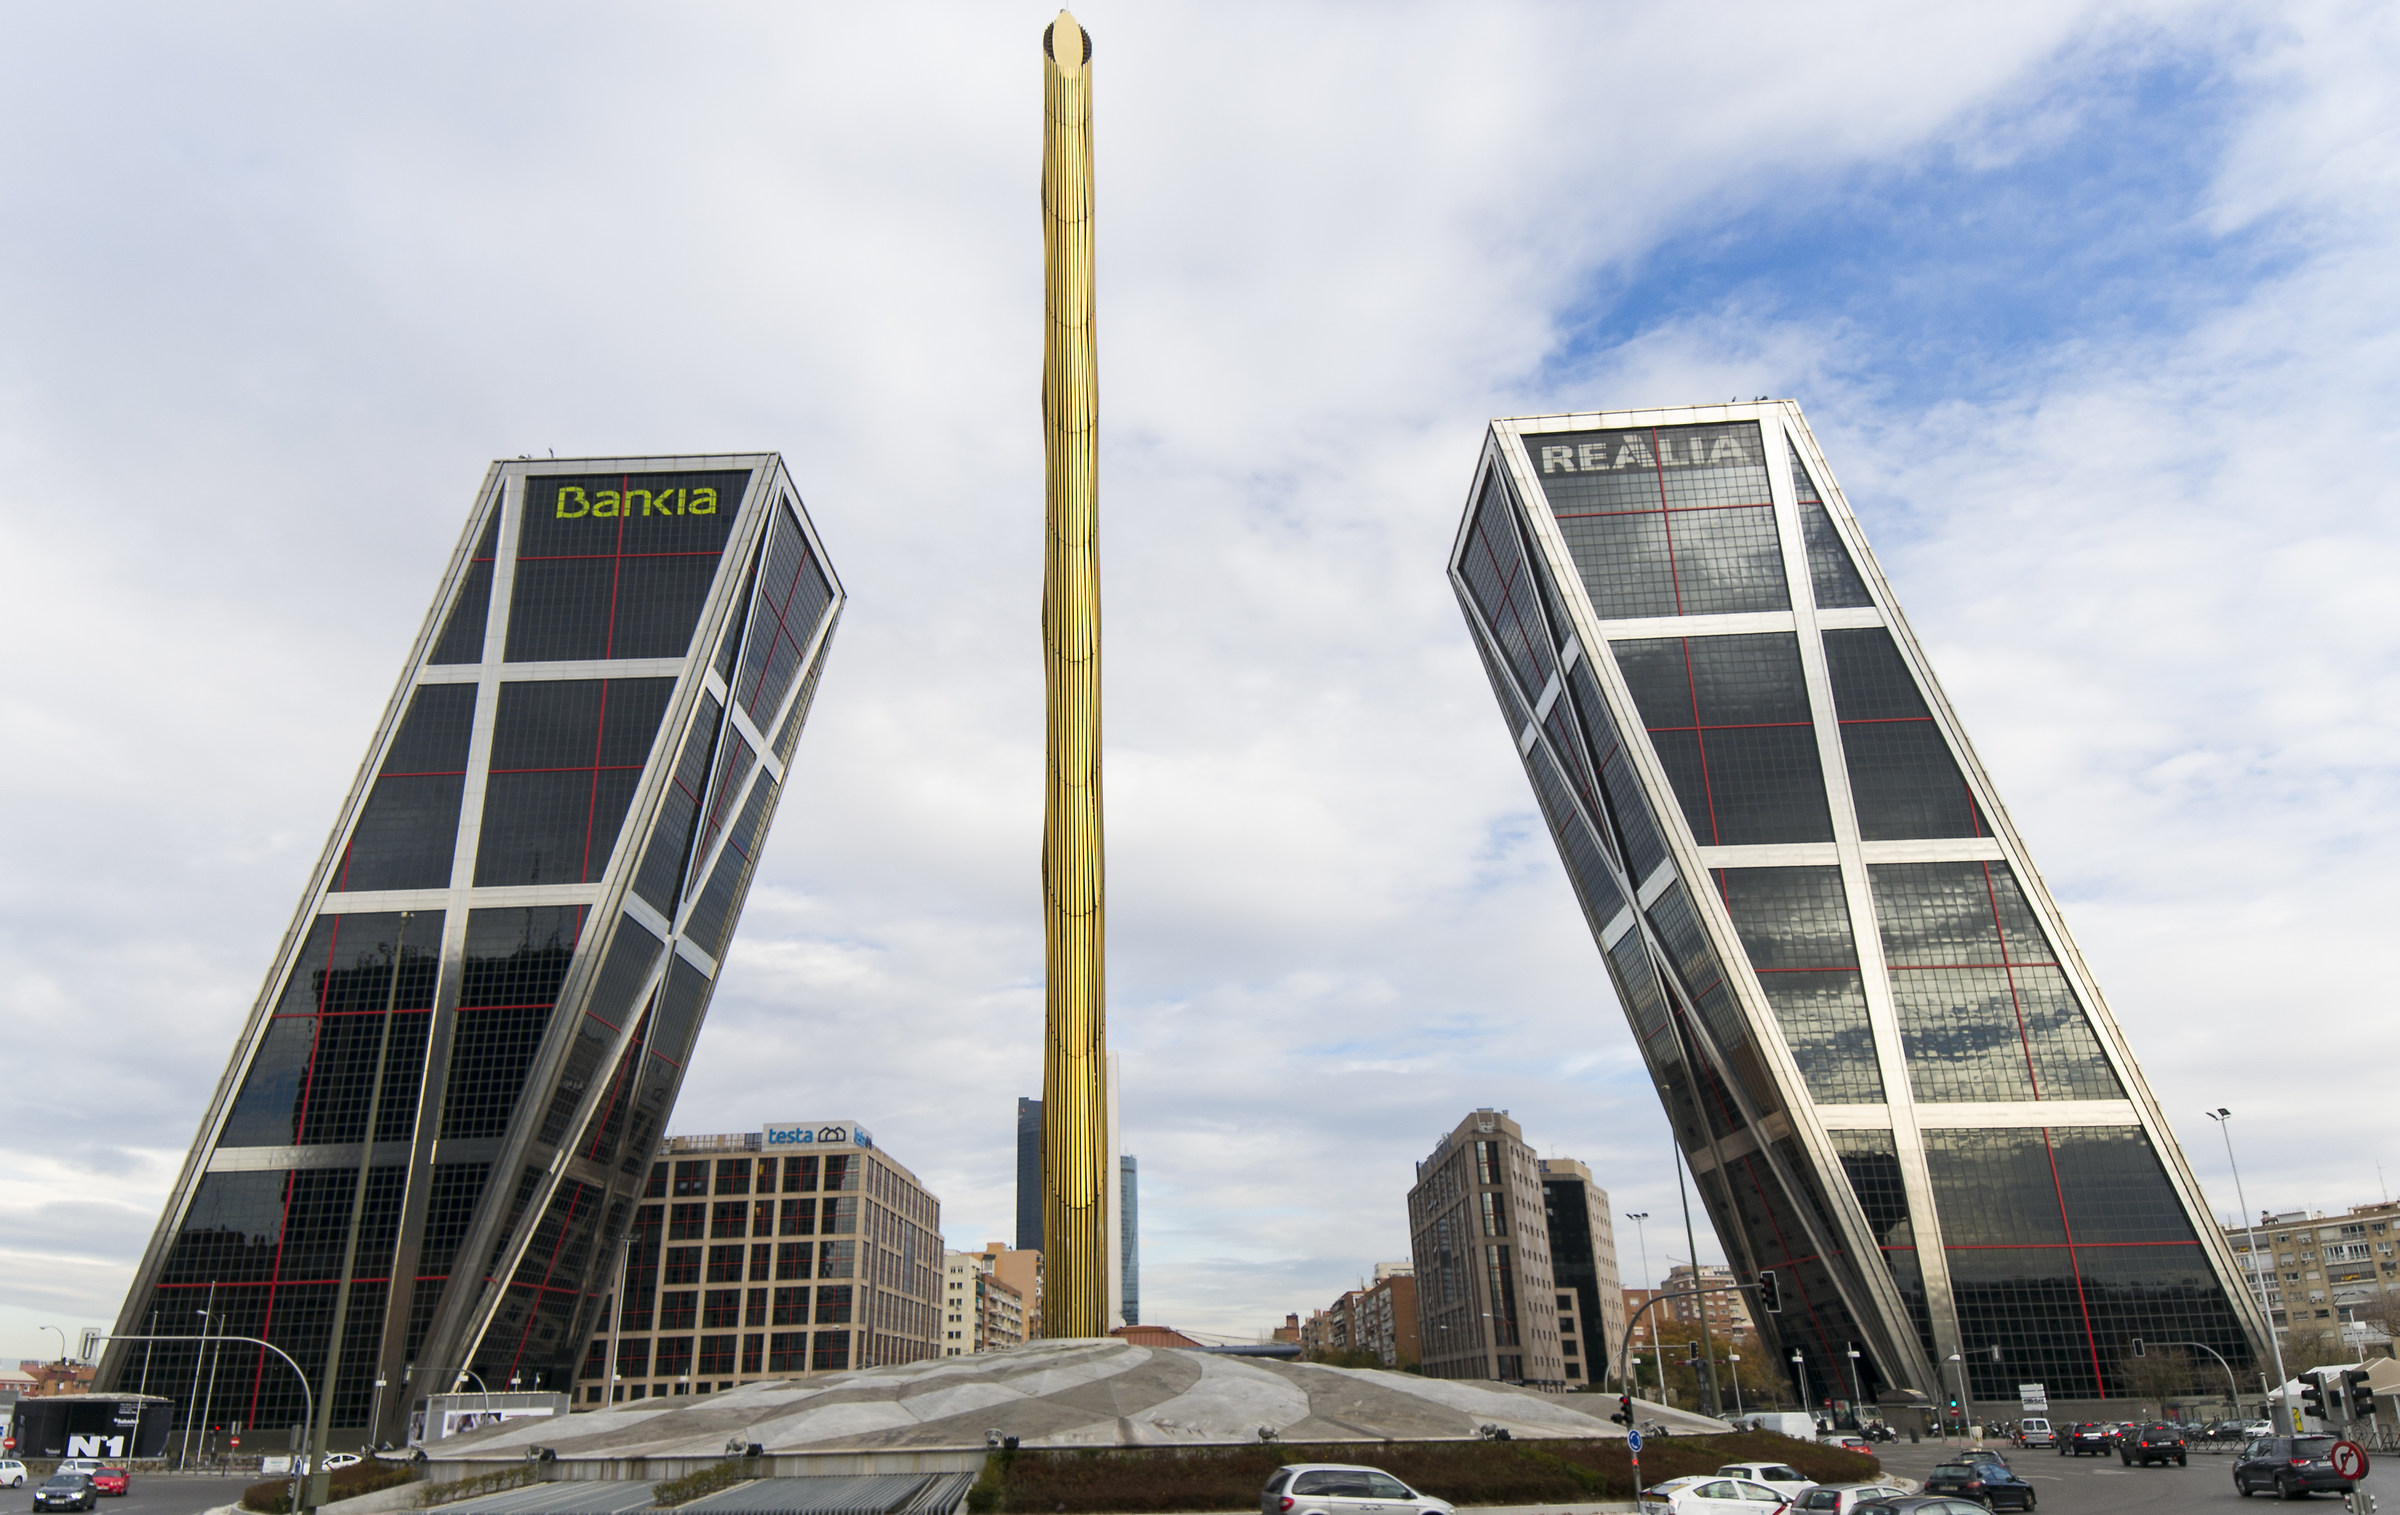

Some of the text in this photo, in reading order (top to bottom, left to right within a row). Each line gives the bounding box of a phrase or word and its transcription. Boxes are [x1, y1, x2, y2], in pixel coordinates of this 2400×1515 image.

[1541, 434, 1750, 474] REALIA
[556, 486, 717, 519] Bankia
[768, 1127, 813, 1144] testa
